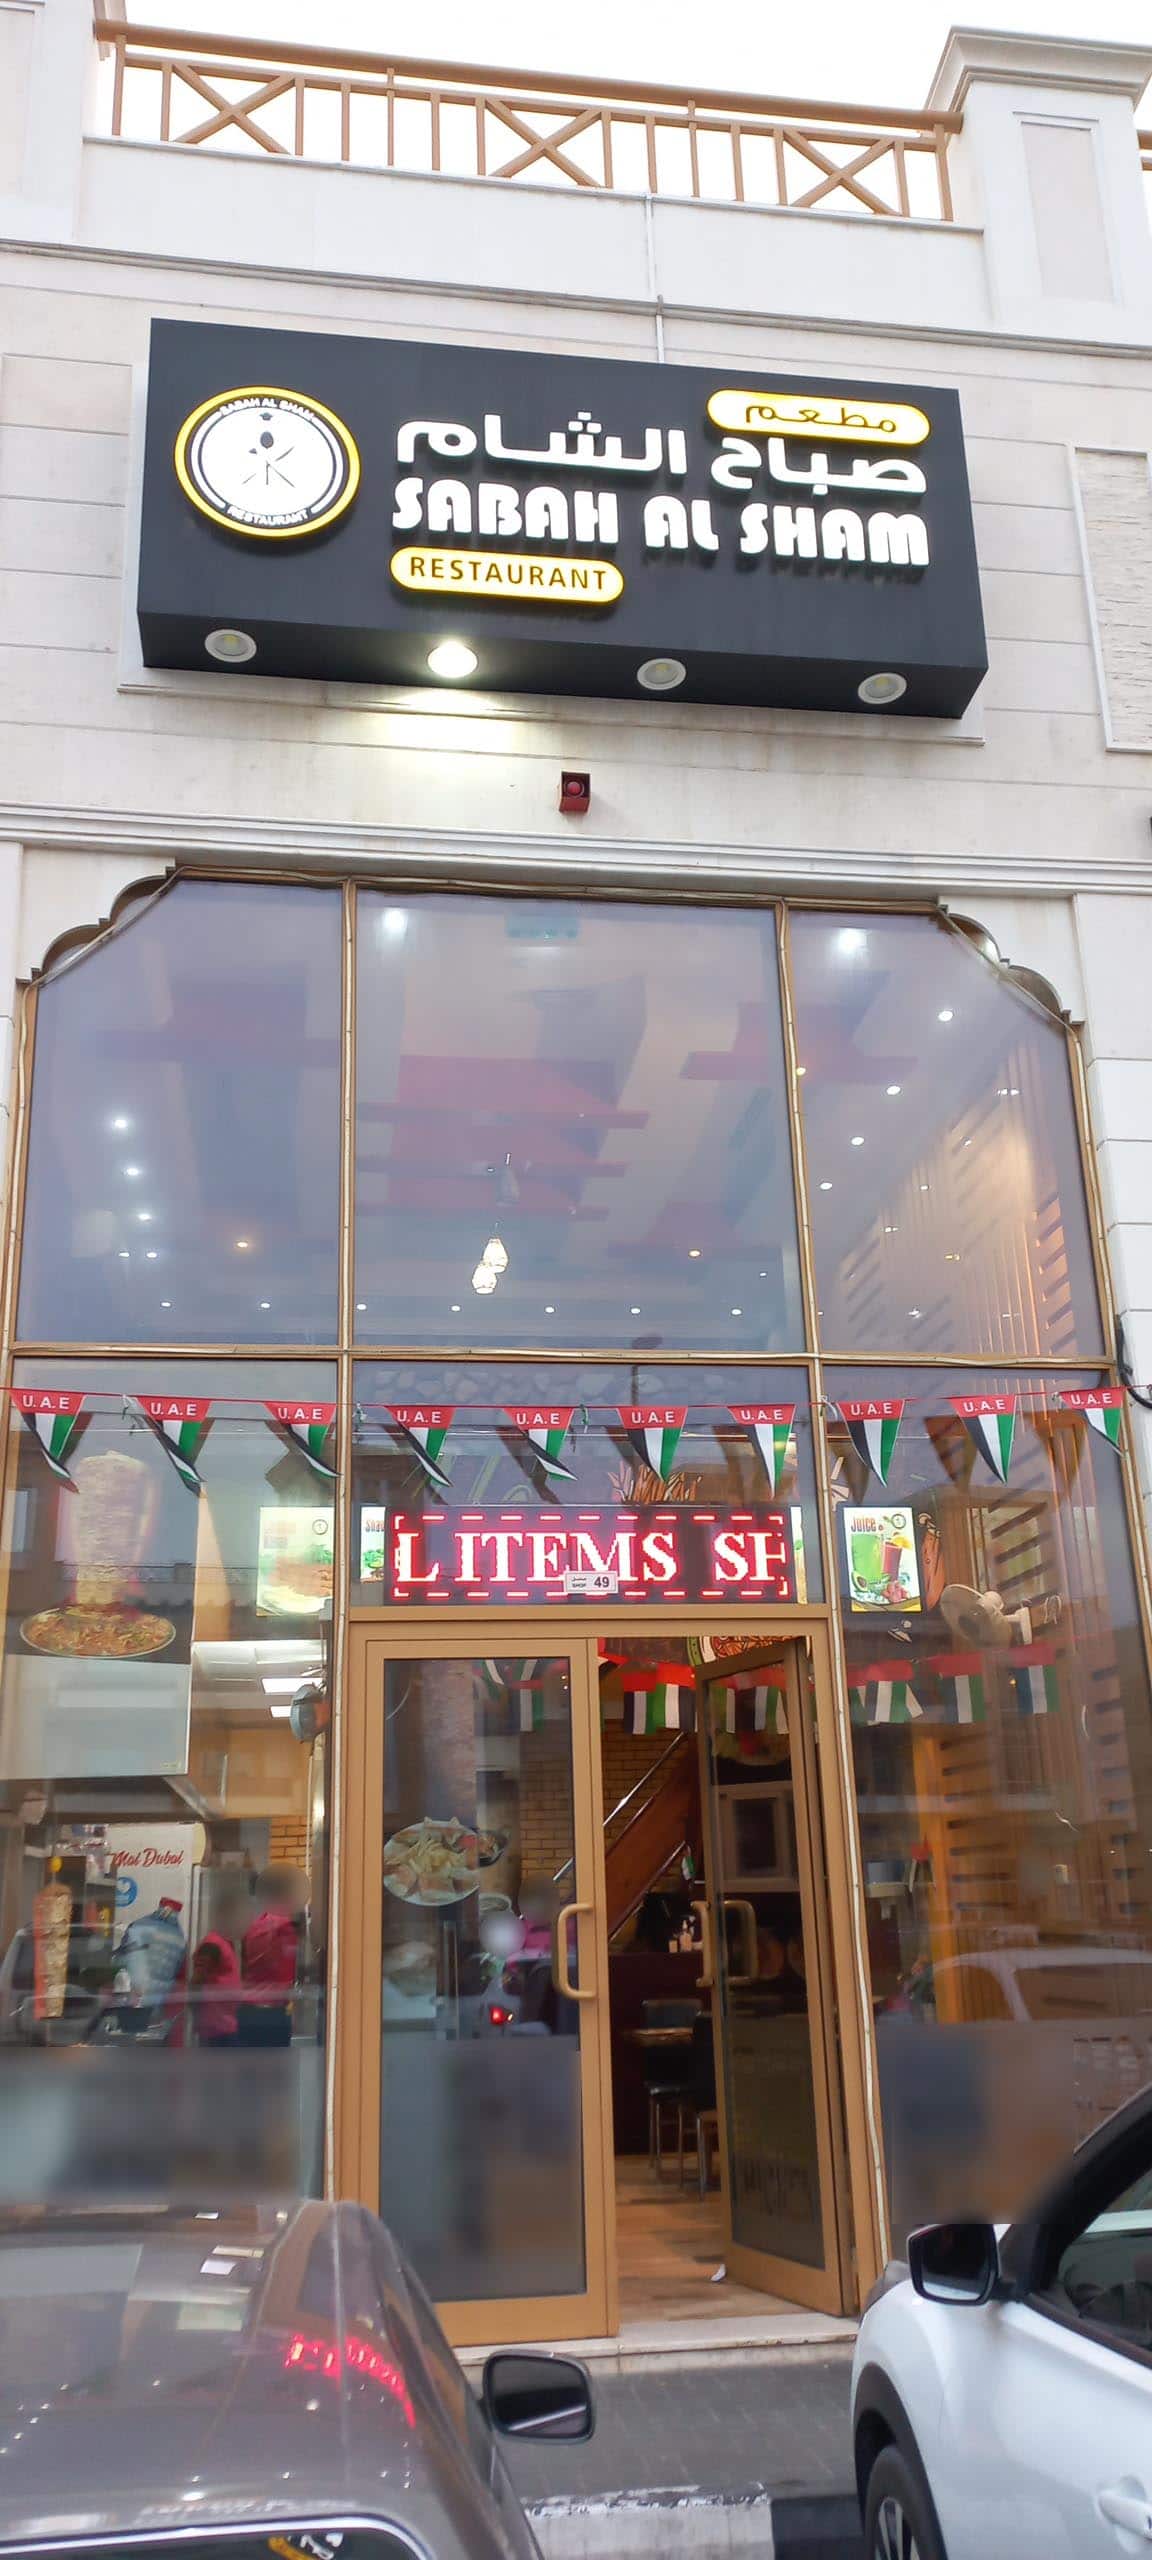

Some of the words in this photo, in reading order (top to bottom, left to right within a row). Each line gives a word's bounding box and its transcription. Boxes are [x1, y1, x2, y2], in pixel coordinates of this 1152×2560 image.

[261, 398, 278, 407] AL
[745, 405, 897, 434] مطعم
[397, 411, 688, 474] الشام
[711, 437, 927, 496] صباح
[227, 506, 309, 526] RESTAURANT
[392, 477, 619, 544] SABAH
[644, 495, 719, 551] AL
[740, 503, 930, 566] SHAM
[410, 556, 607, 590] RESTAURANT
[454, 1532, 678, 1582] ITEMS
[594, 1576, 610, 1588] 49
